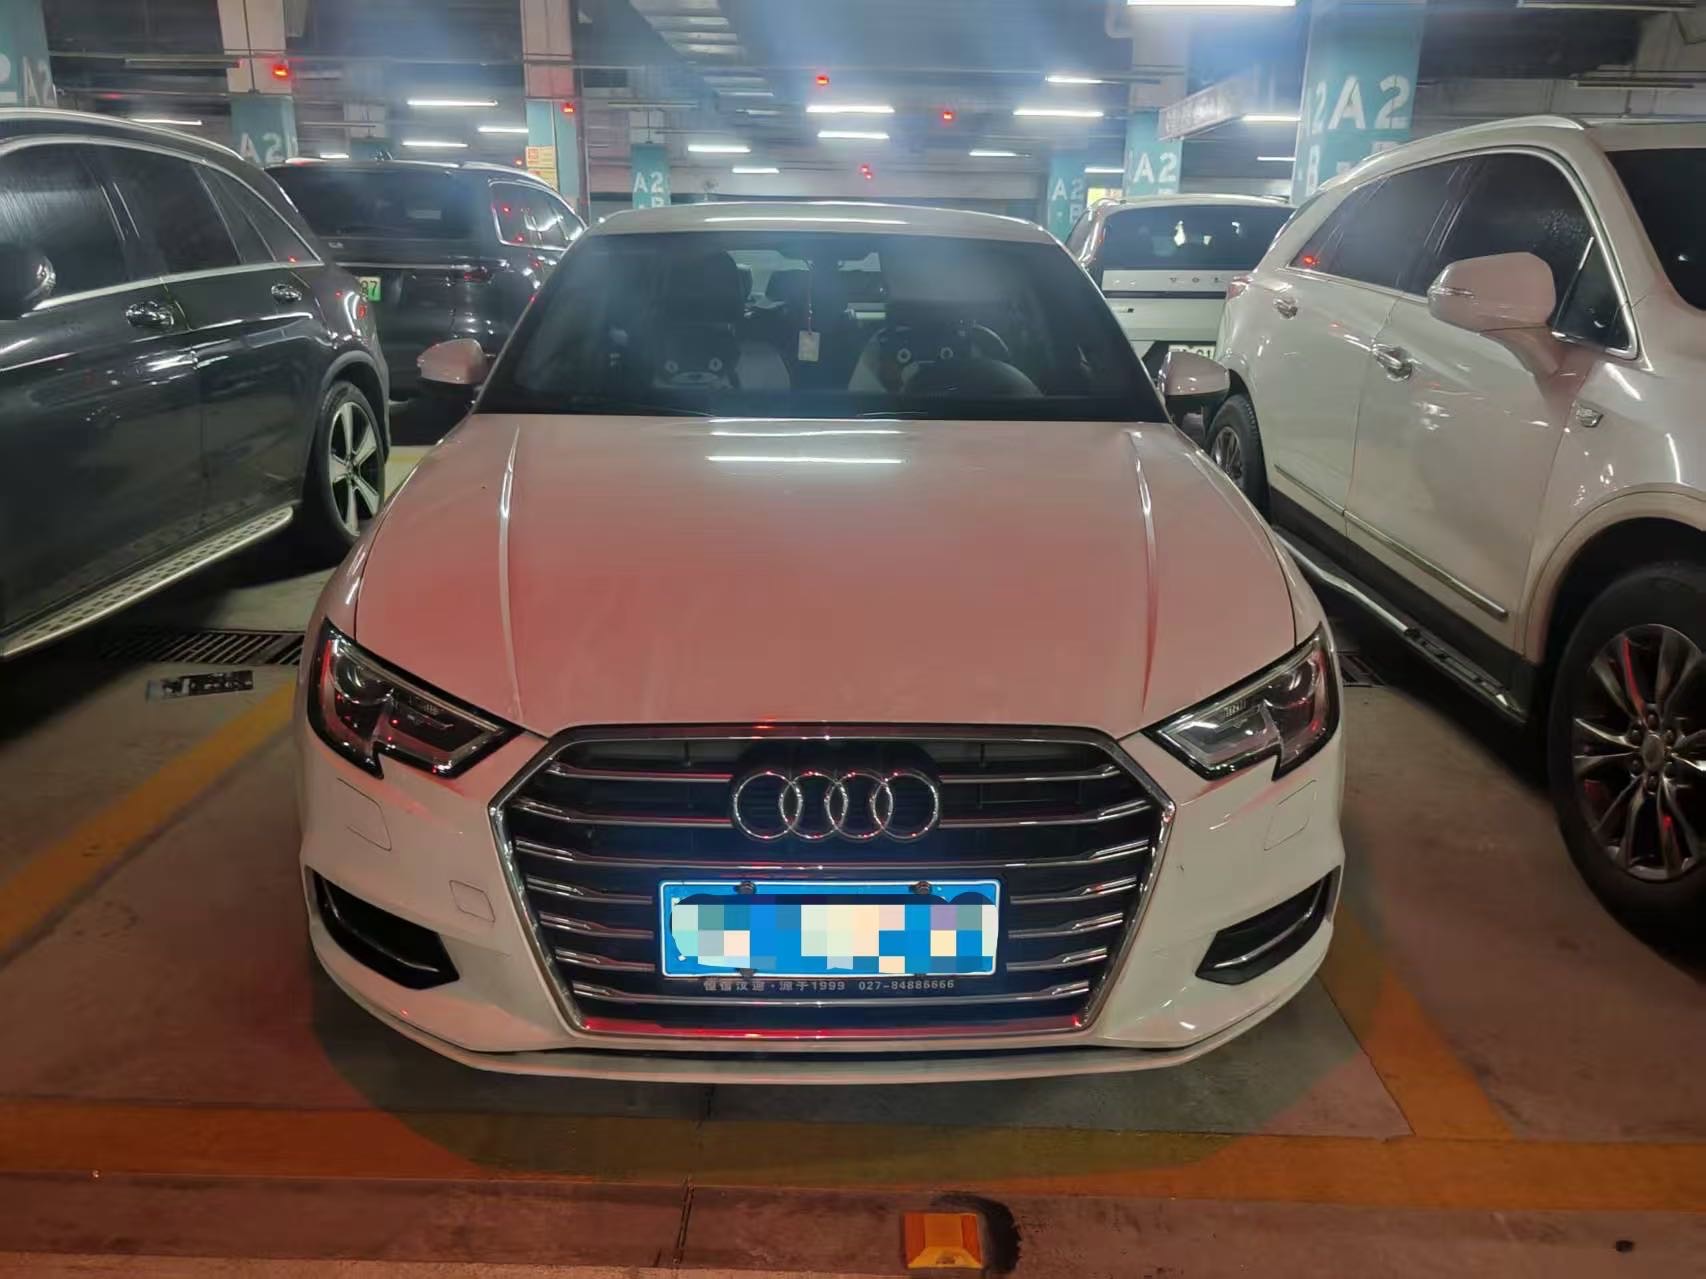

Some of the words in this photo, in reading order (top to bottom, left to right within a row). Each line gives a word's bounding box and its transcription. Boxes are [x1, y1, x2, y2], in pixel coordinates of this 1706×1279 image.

[1327, 75, 1411, 129] A2
[239, 132, 285, 164] A2
[633, 171, 664, 193] A2
[1133, 152, 1177, 183] A2
[1052, 177, 1084, 200] A2
